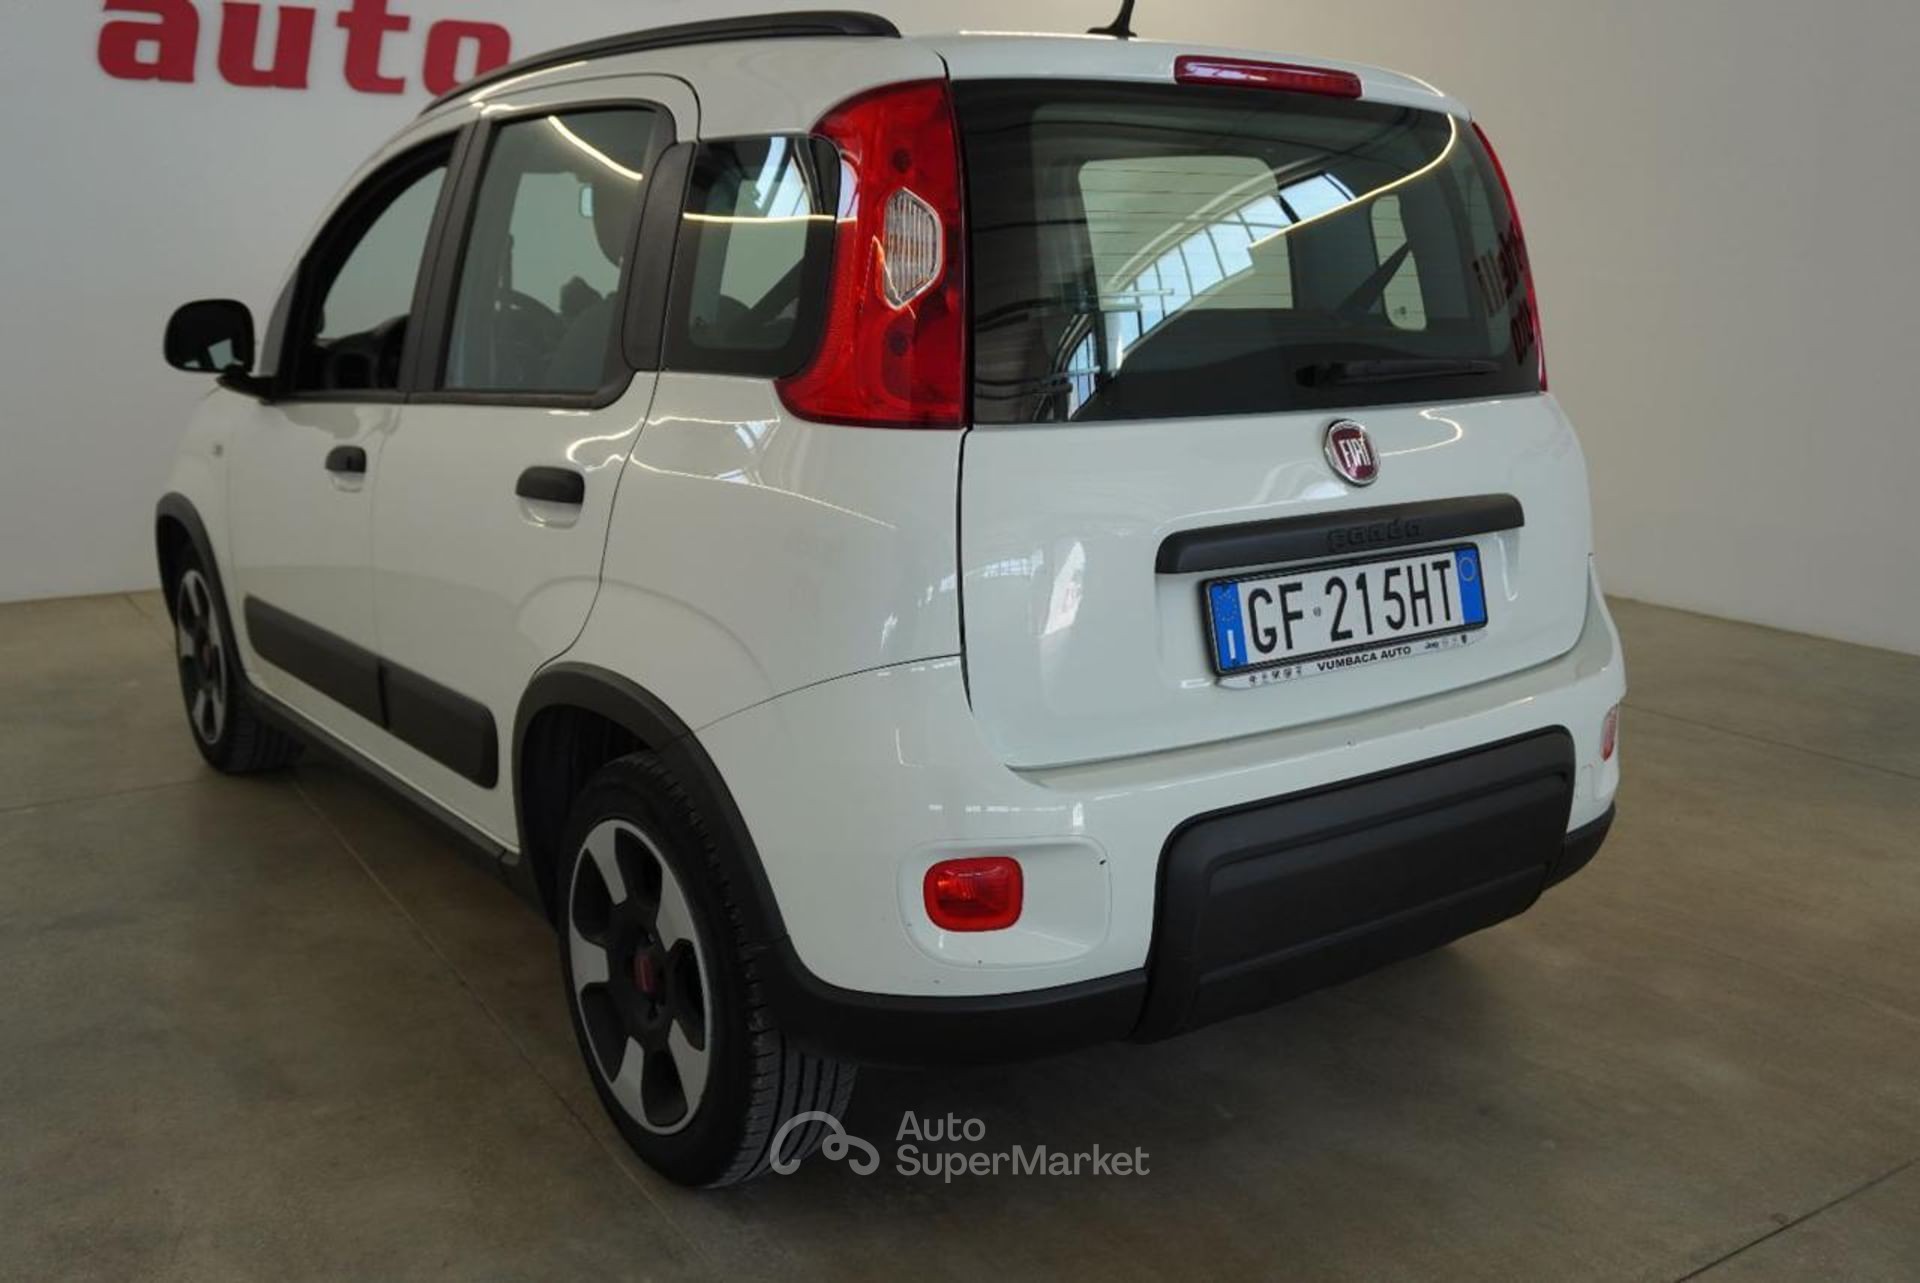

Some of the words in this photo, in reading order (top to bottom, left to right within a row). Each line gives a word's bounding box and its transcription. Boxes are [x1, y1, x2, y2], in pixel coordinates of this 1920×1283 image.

[97, 0, 511, 98] auto
[1338, 438, 1371, 468] FIAT
[1248, 582, 1304, 654] GF
[1325, 560, 1451, 642] 215HT
[1317, 653, 1378, 672] VUMBACA
[1381, 646, 1412, 659] AUTO
